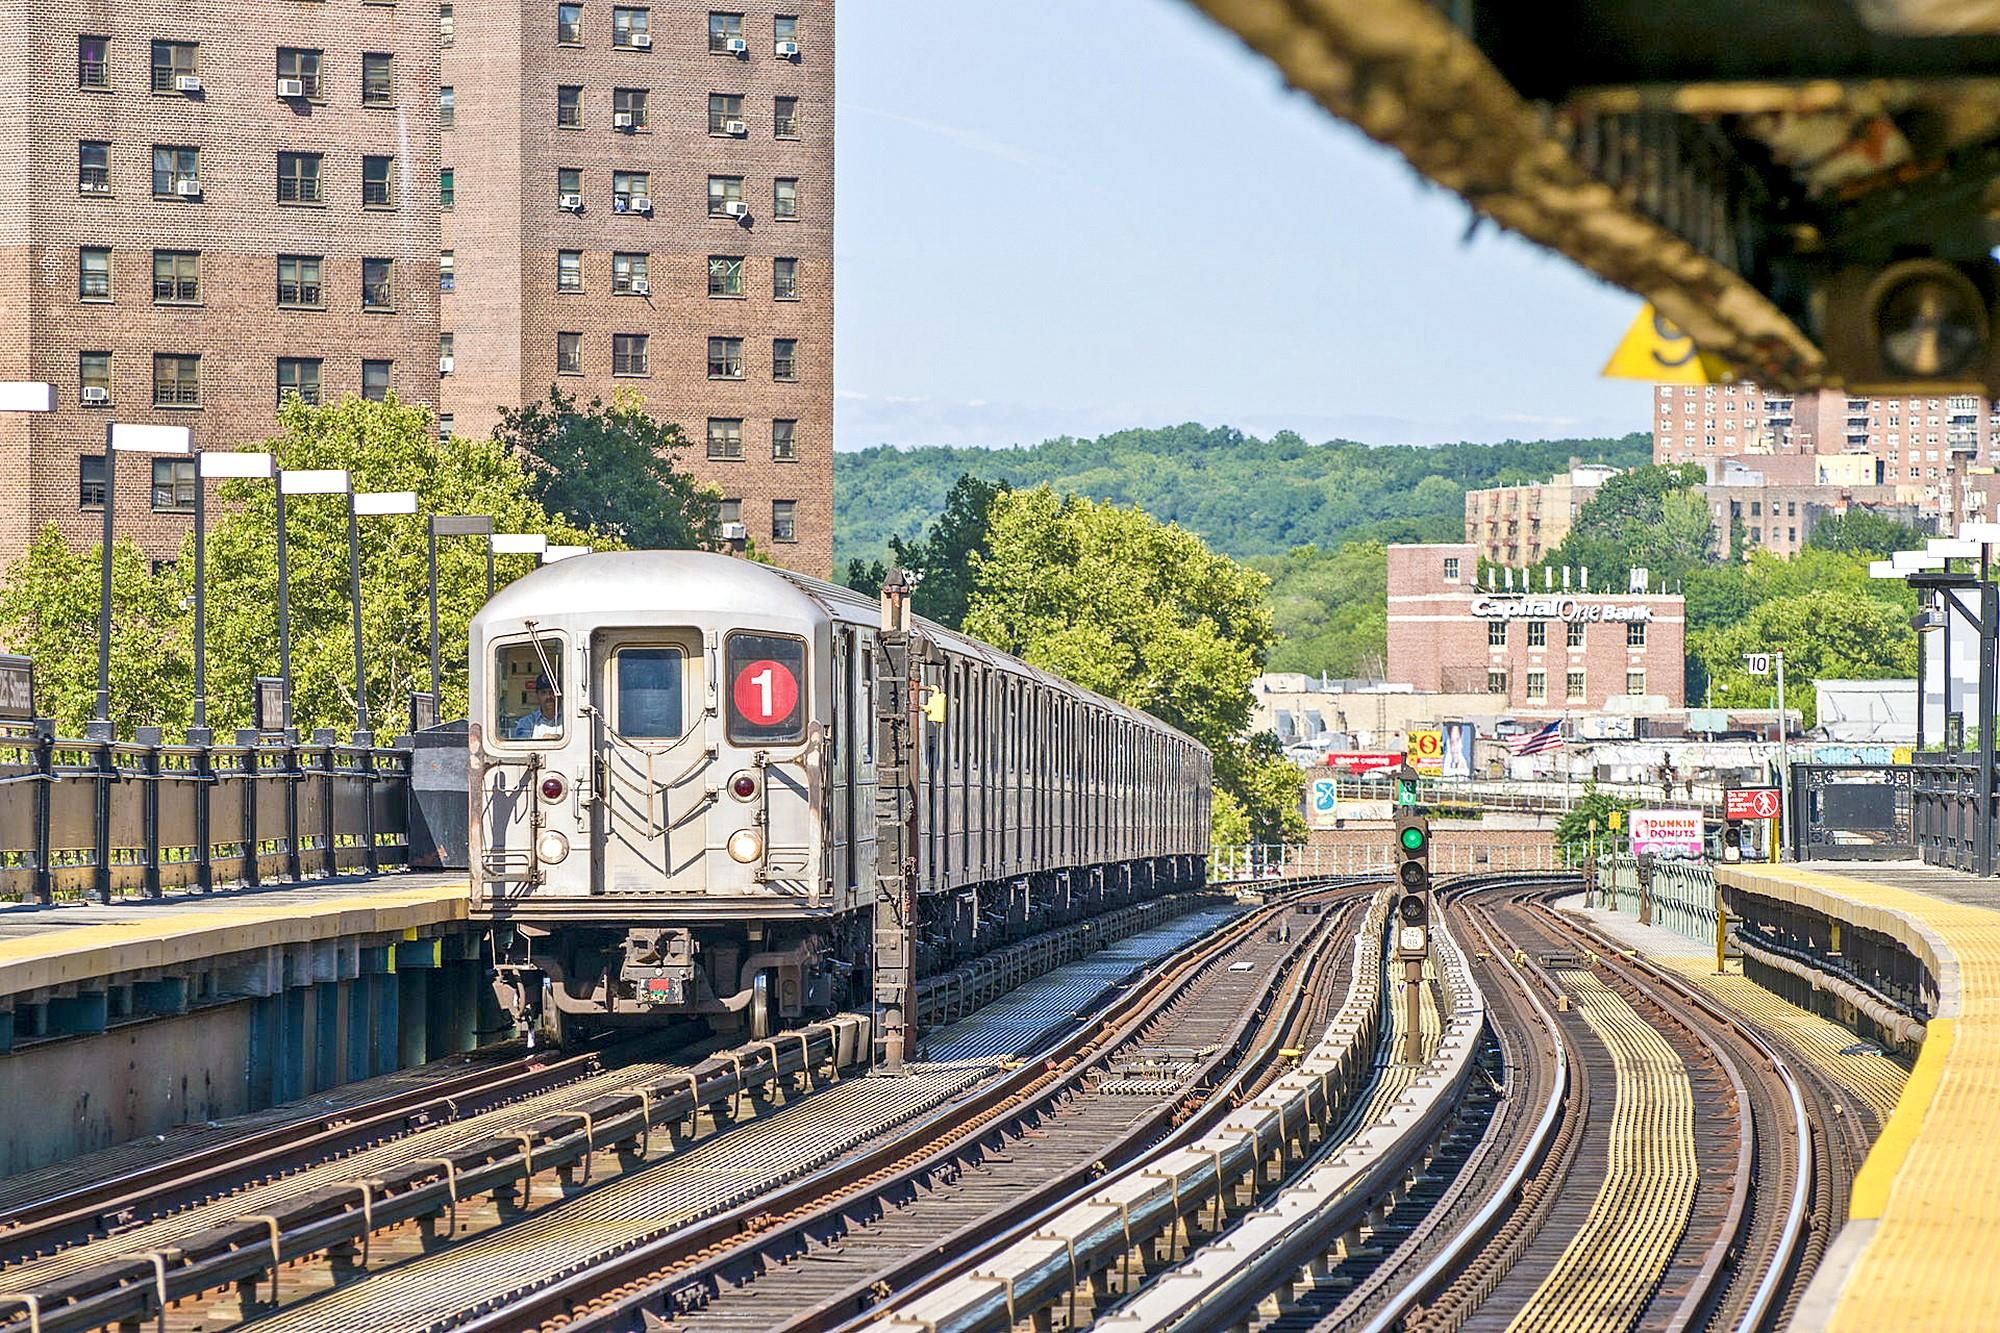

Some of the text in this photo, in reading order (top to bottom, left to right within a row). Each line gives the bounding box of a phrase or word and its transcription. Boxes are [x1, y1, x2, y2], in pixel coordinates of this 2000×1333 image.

[1602, 604, 1654, 622] Bank
[1752, 656, 1767, 671] 10
[751, 669, 772, 716] 1
[1650, 819, 1698, 828] DUNKIN'
[1650, 829, 1696, 839] DONUTS
